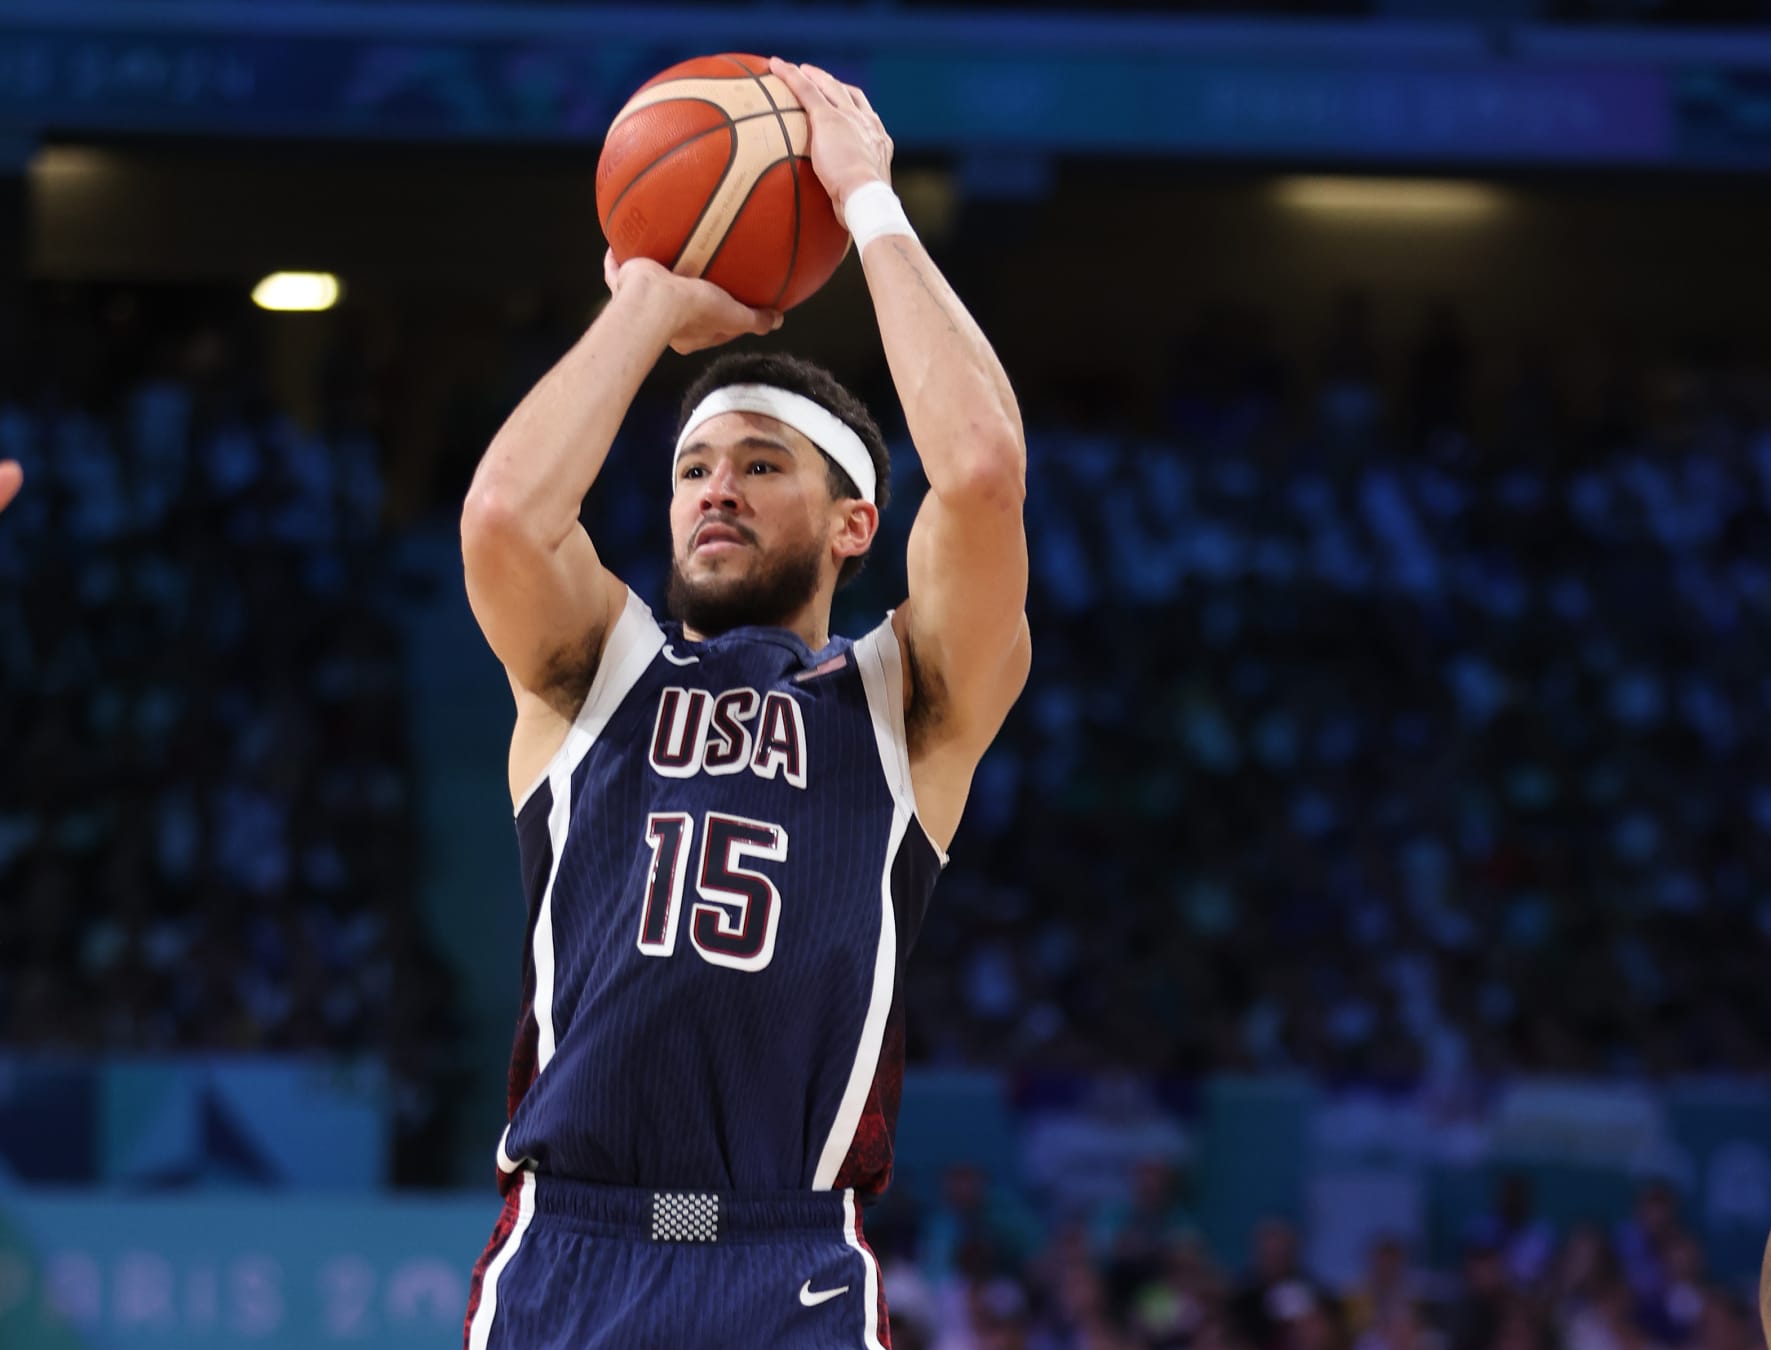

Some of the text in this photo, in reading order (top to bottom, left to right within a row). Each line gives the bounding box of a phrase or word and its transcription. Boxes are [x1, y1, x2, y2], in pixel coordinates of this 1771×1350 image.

[649, 687, 807, 789] USA
[637, 811, 788, 972] 15
[318, 1252, 468, 1342] 20
